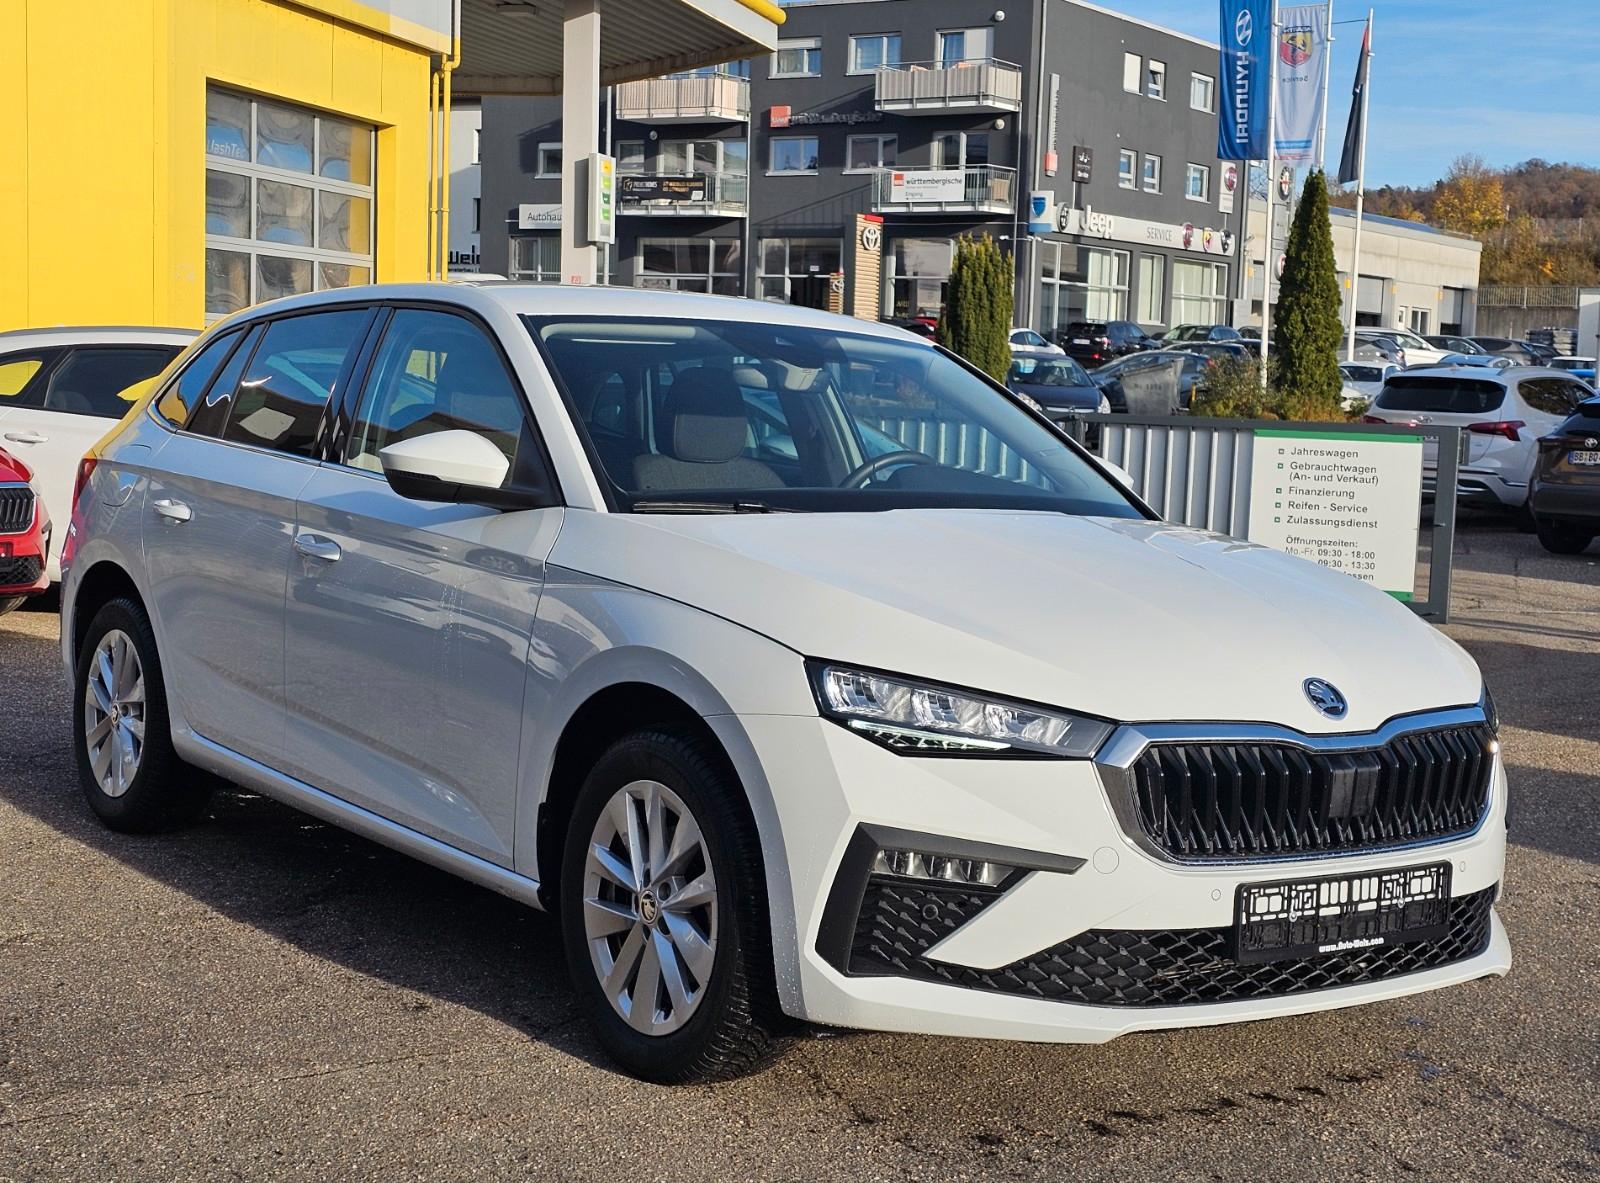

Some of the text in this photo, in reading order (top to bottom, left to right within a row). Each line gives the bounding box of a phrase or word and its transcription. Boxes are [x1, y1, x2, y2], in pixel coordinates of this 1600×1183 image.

[906, 176, 962, 186] württembergische
[1080, 204, 1173, 242] Jeep SERVICE
[1290, 447, 1359, 460] Jahreswagen
[1290, 461, 1377, 475] Gebrauchtwagen
[1289, 471, 1379, 486] (An- und Verkauf)
[1288, 486, 1355, 500] Finanzierung
[1288, 501, 1320, 511] Reifen
[1330, 503, 1368, 513] Service
[1286, 515, 1378, 529] Zulassungsdienst
[1286, 534, 1358, 548] Öffnungszeiten:
[1285, 546, 1315, 556] Mo.-Fr.
[1317, 548, 1342, 557] 09:30
[1351, 550, 1375, 559] 18:00
[1317, 559, 1342, 568] 09:30
[1351, 561, 1375, 570] 13:30
